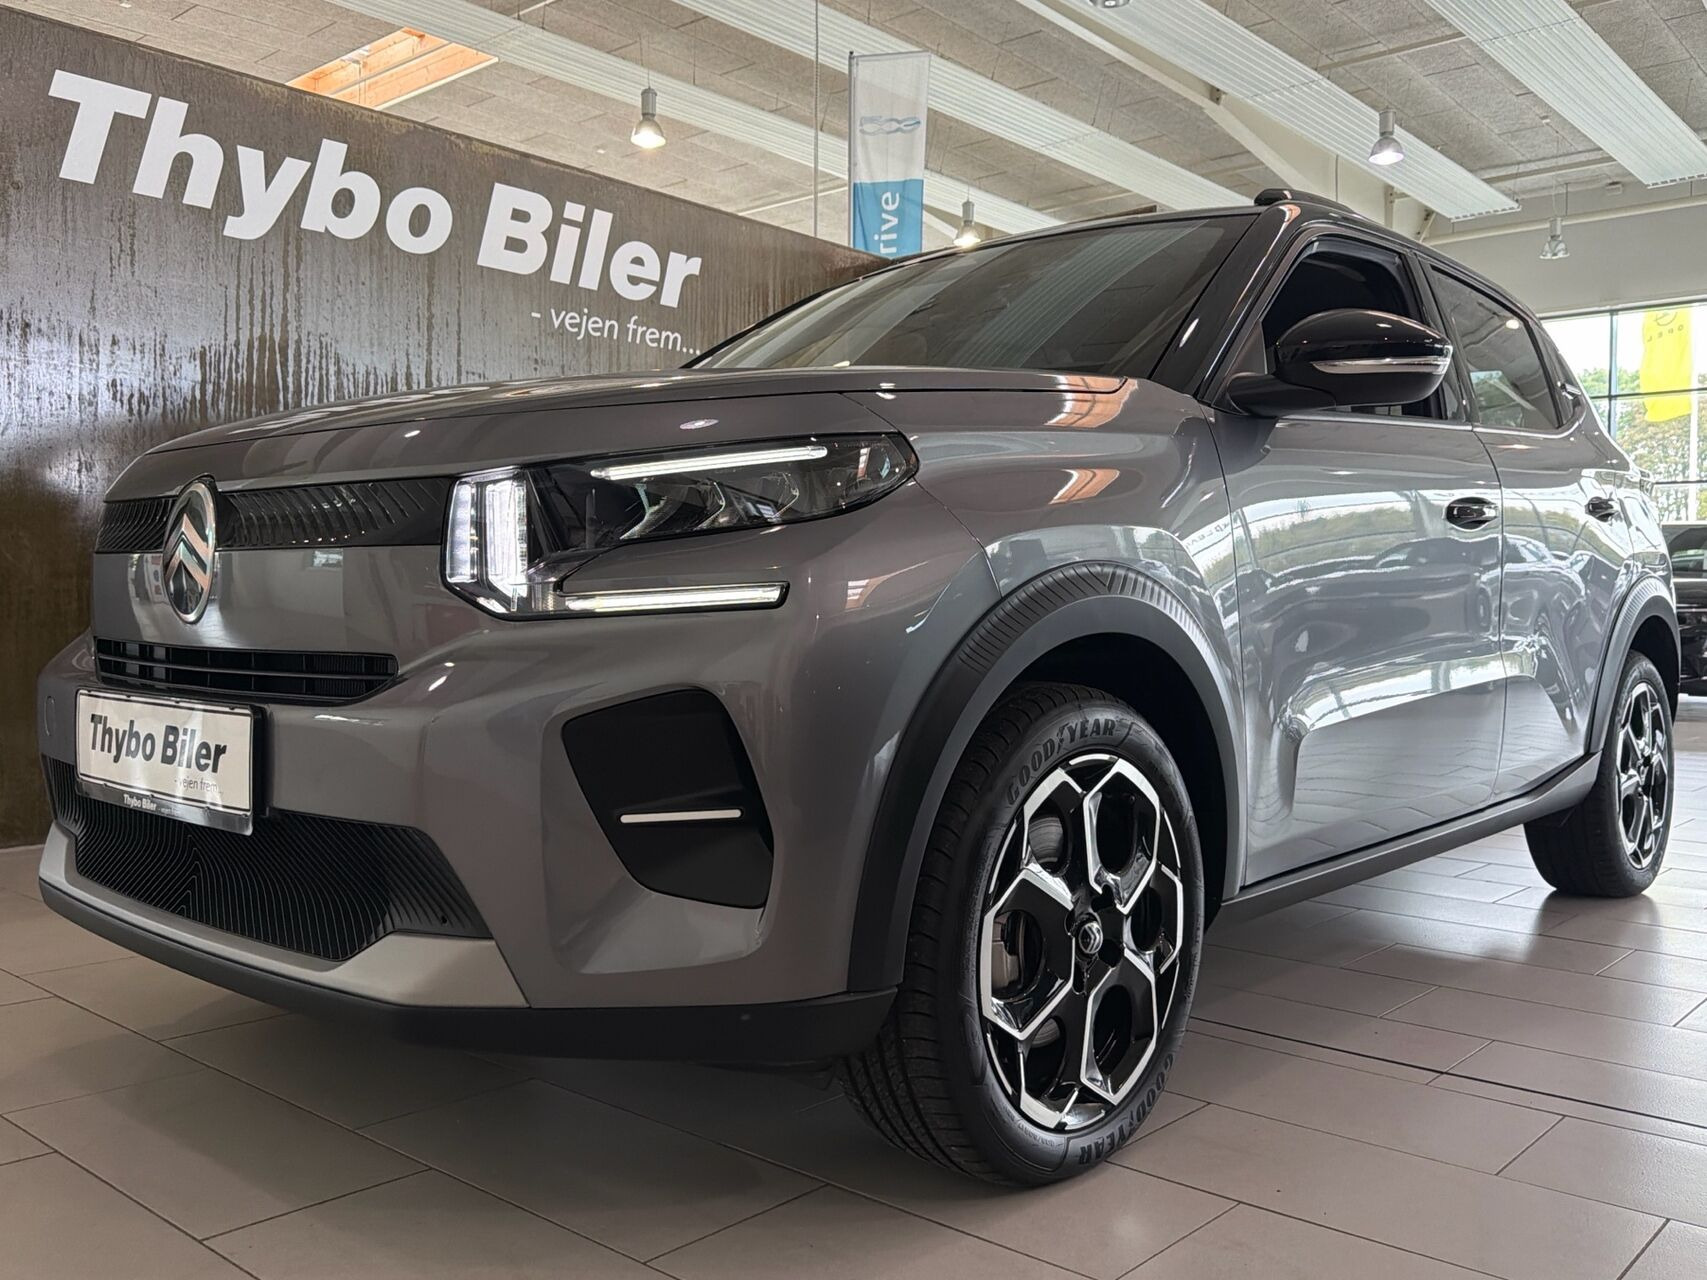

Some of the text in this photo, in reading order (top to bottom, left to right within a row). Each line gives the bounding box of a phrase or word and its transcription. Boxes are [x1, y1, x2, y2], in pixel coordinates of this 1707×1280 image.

[48, 69, 702, 308] Thybo Biler
[550, 308, 619, 340] vejen
[627, 315, 701, 355] frem...
[90, 713, 227, 773] Thybo Biler
[1007, 718, 1117, 806] GOODYEAR
[123, 793, 142, 808] Thybo
[179, 776, 199, 791] ejen
[1079, 1053, 1174, 1165] GOODYEAR
